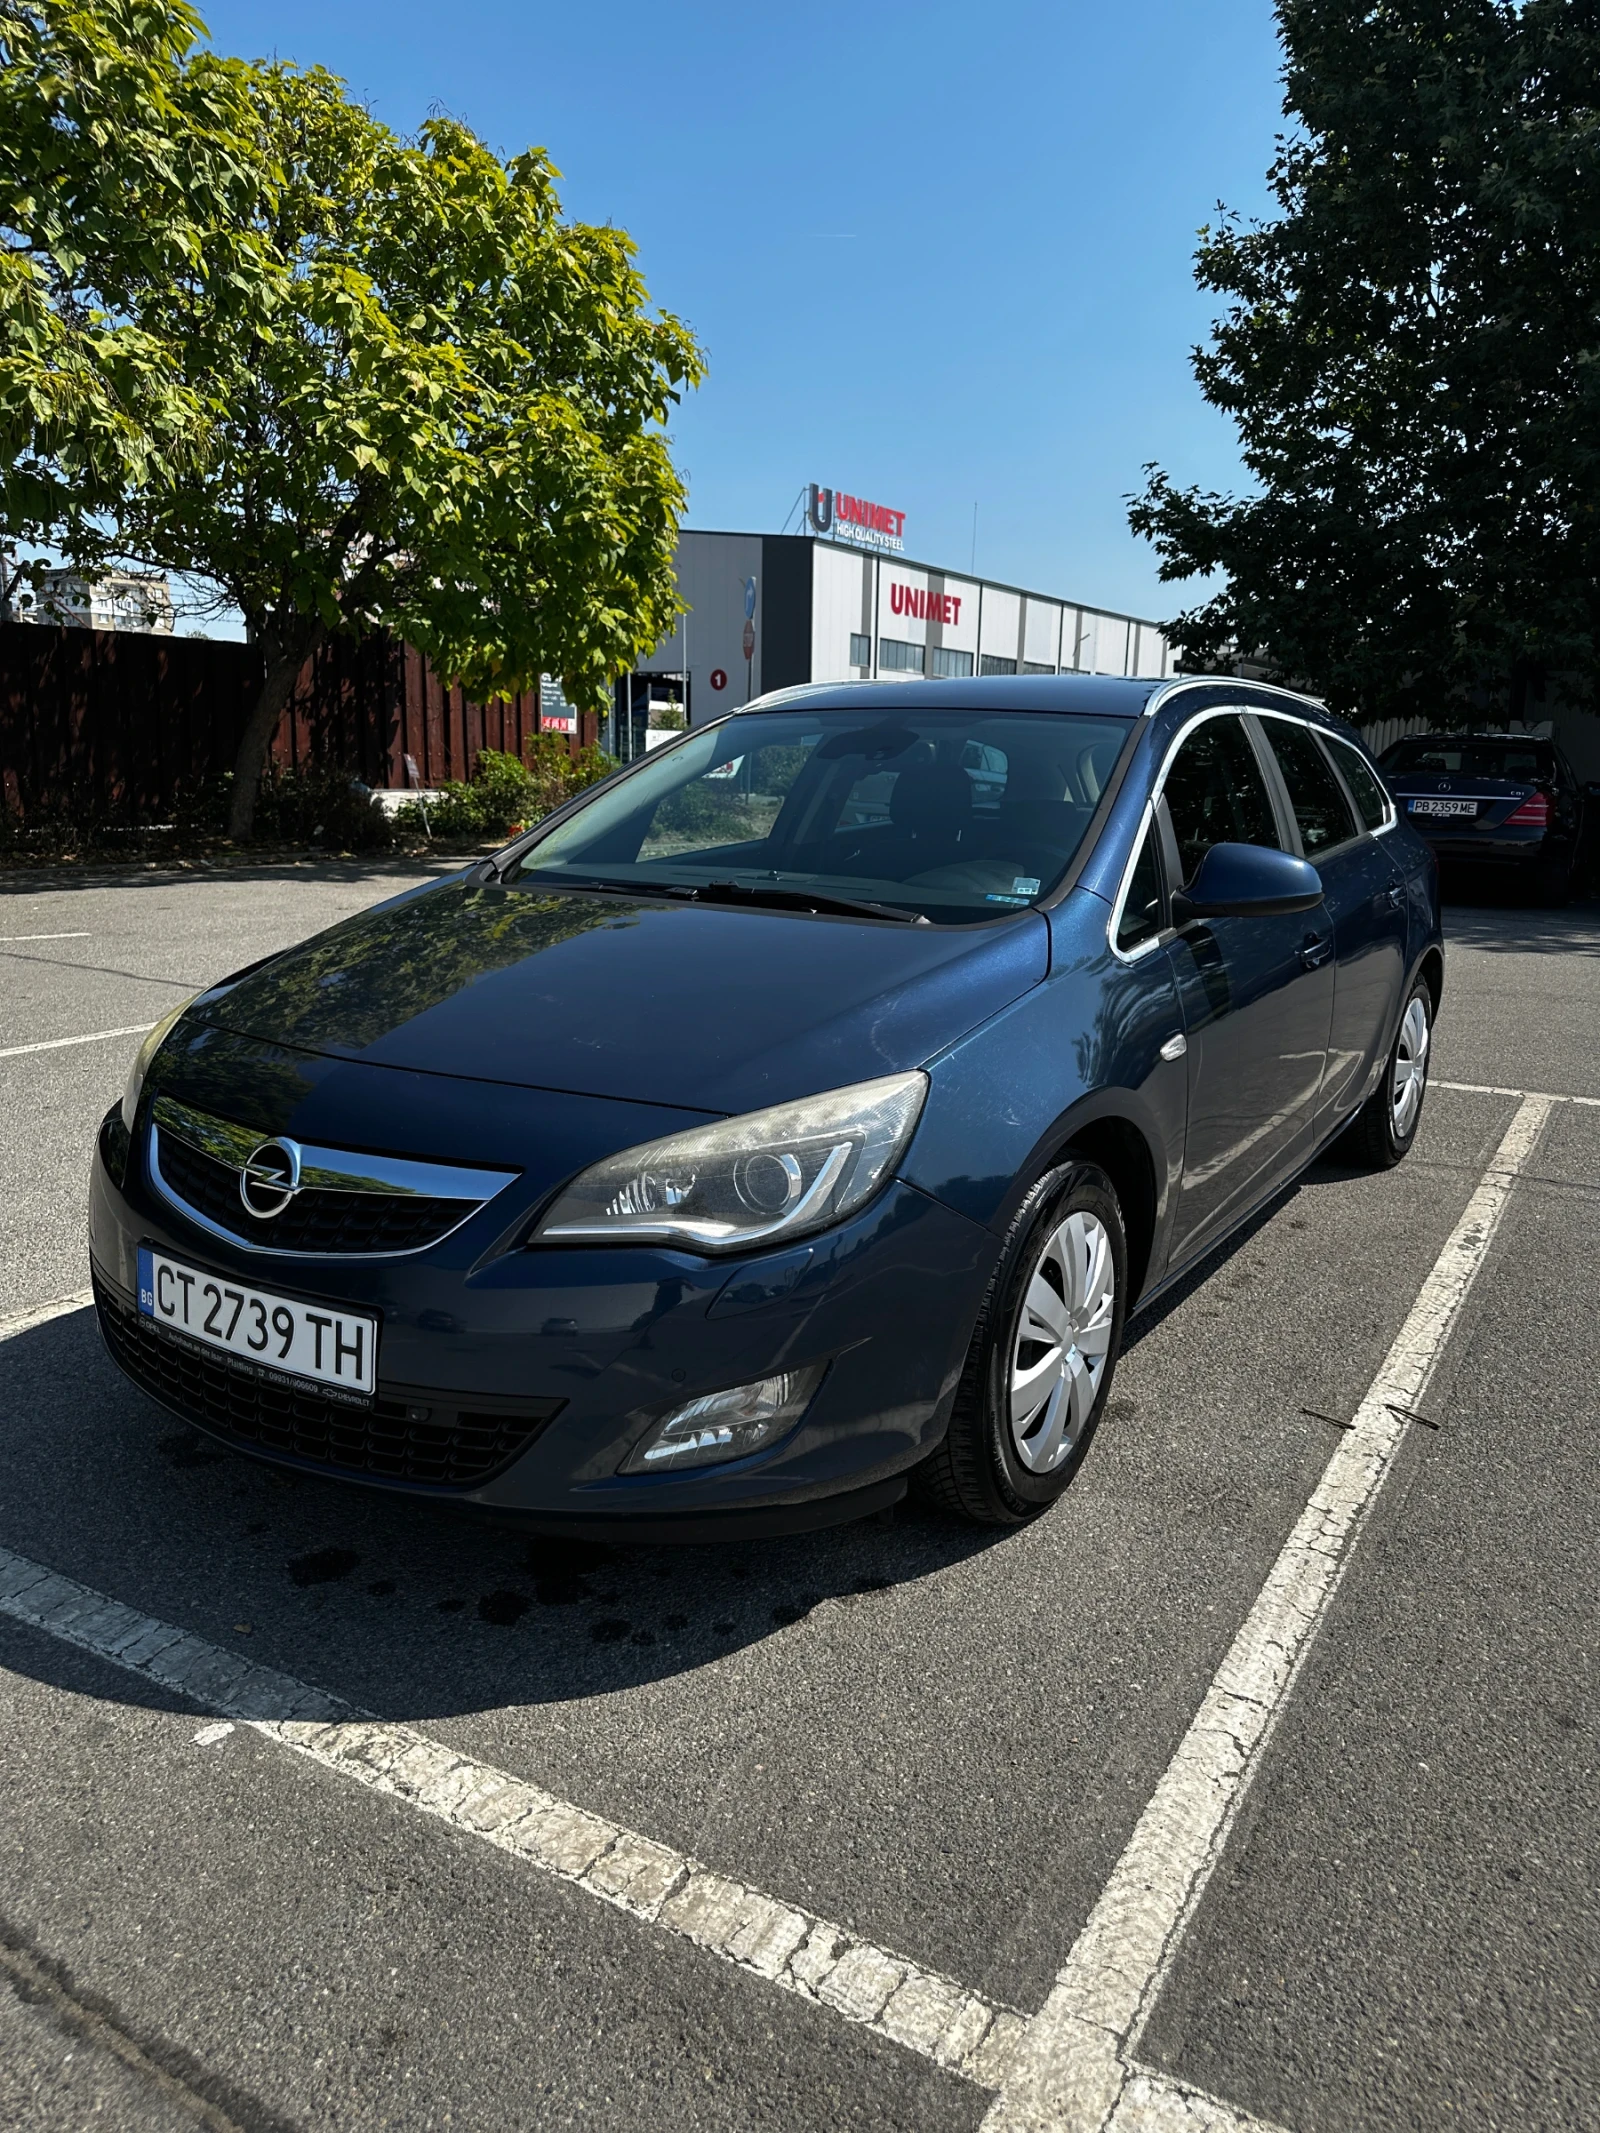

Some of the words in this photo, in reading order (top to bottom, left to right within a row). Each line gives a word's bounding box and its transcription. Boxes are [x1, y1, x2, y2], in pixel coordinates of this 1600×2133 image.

[836, 491, 905, 537] UNIMET
[837, 523, 854, 538] HIGH
[855, 528, 884, 546] QUALITY
[884, 536, 904, 551] STEEL
[891, 583, 961, 625] UNIMET
[715, 674, 722, 686] 1
[1415, 801, 1430, 812] PB
[1431, 802, 1458, 813] 2359
[1460, 803, 1476, 814] ME
[141, 1288, 153, 1306] BG
[145, 1321, 161, 1334] OPEL
[157, 1265, 195, 1324] CT
[203, 1283, 295, 1359] 2739
[306, 1313, 363, 1380] TH
[337, 1392, 370, 1407] CHEVROLET
